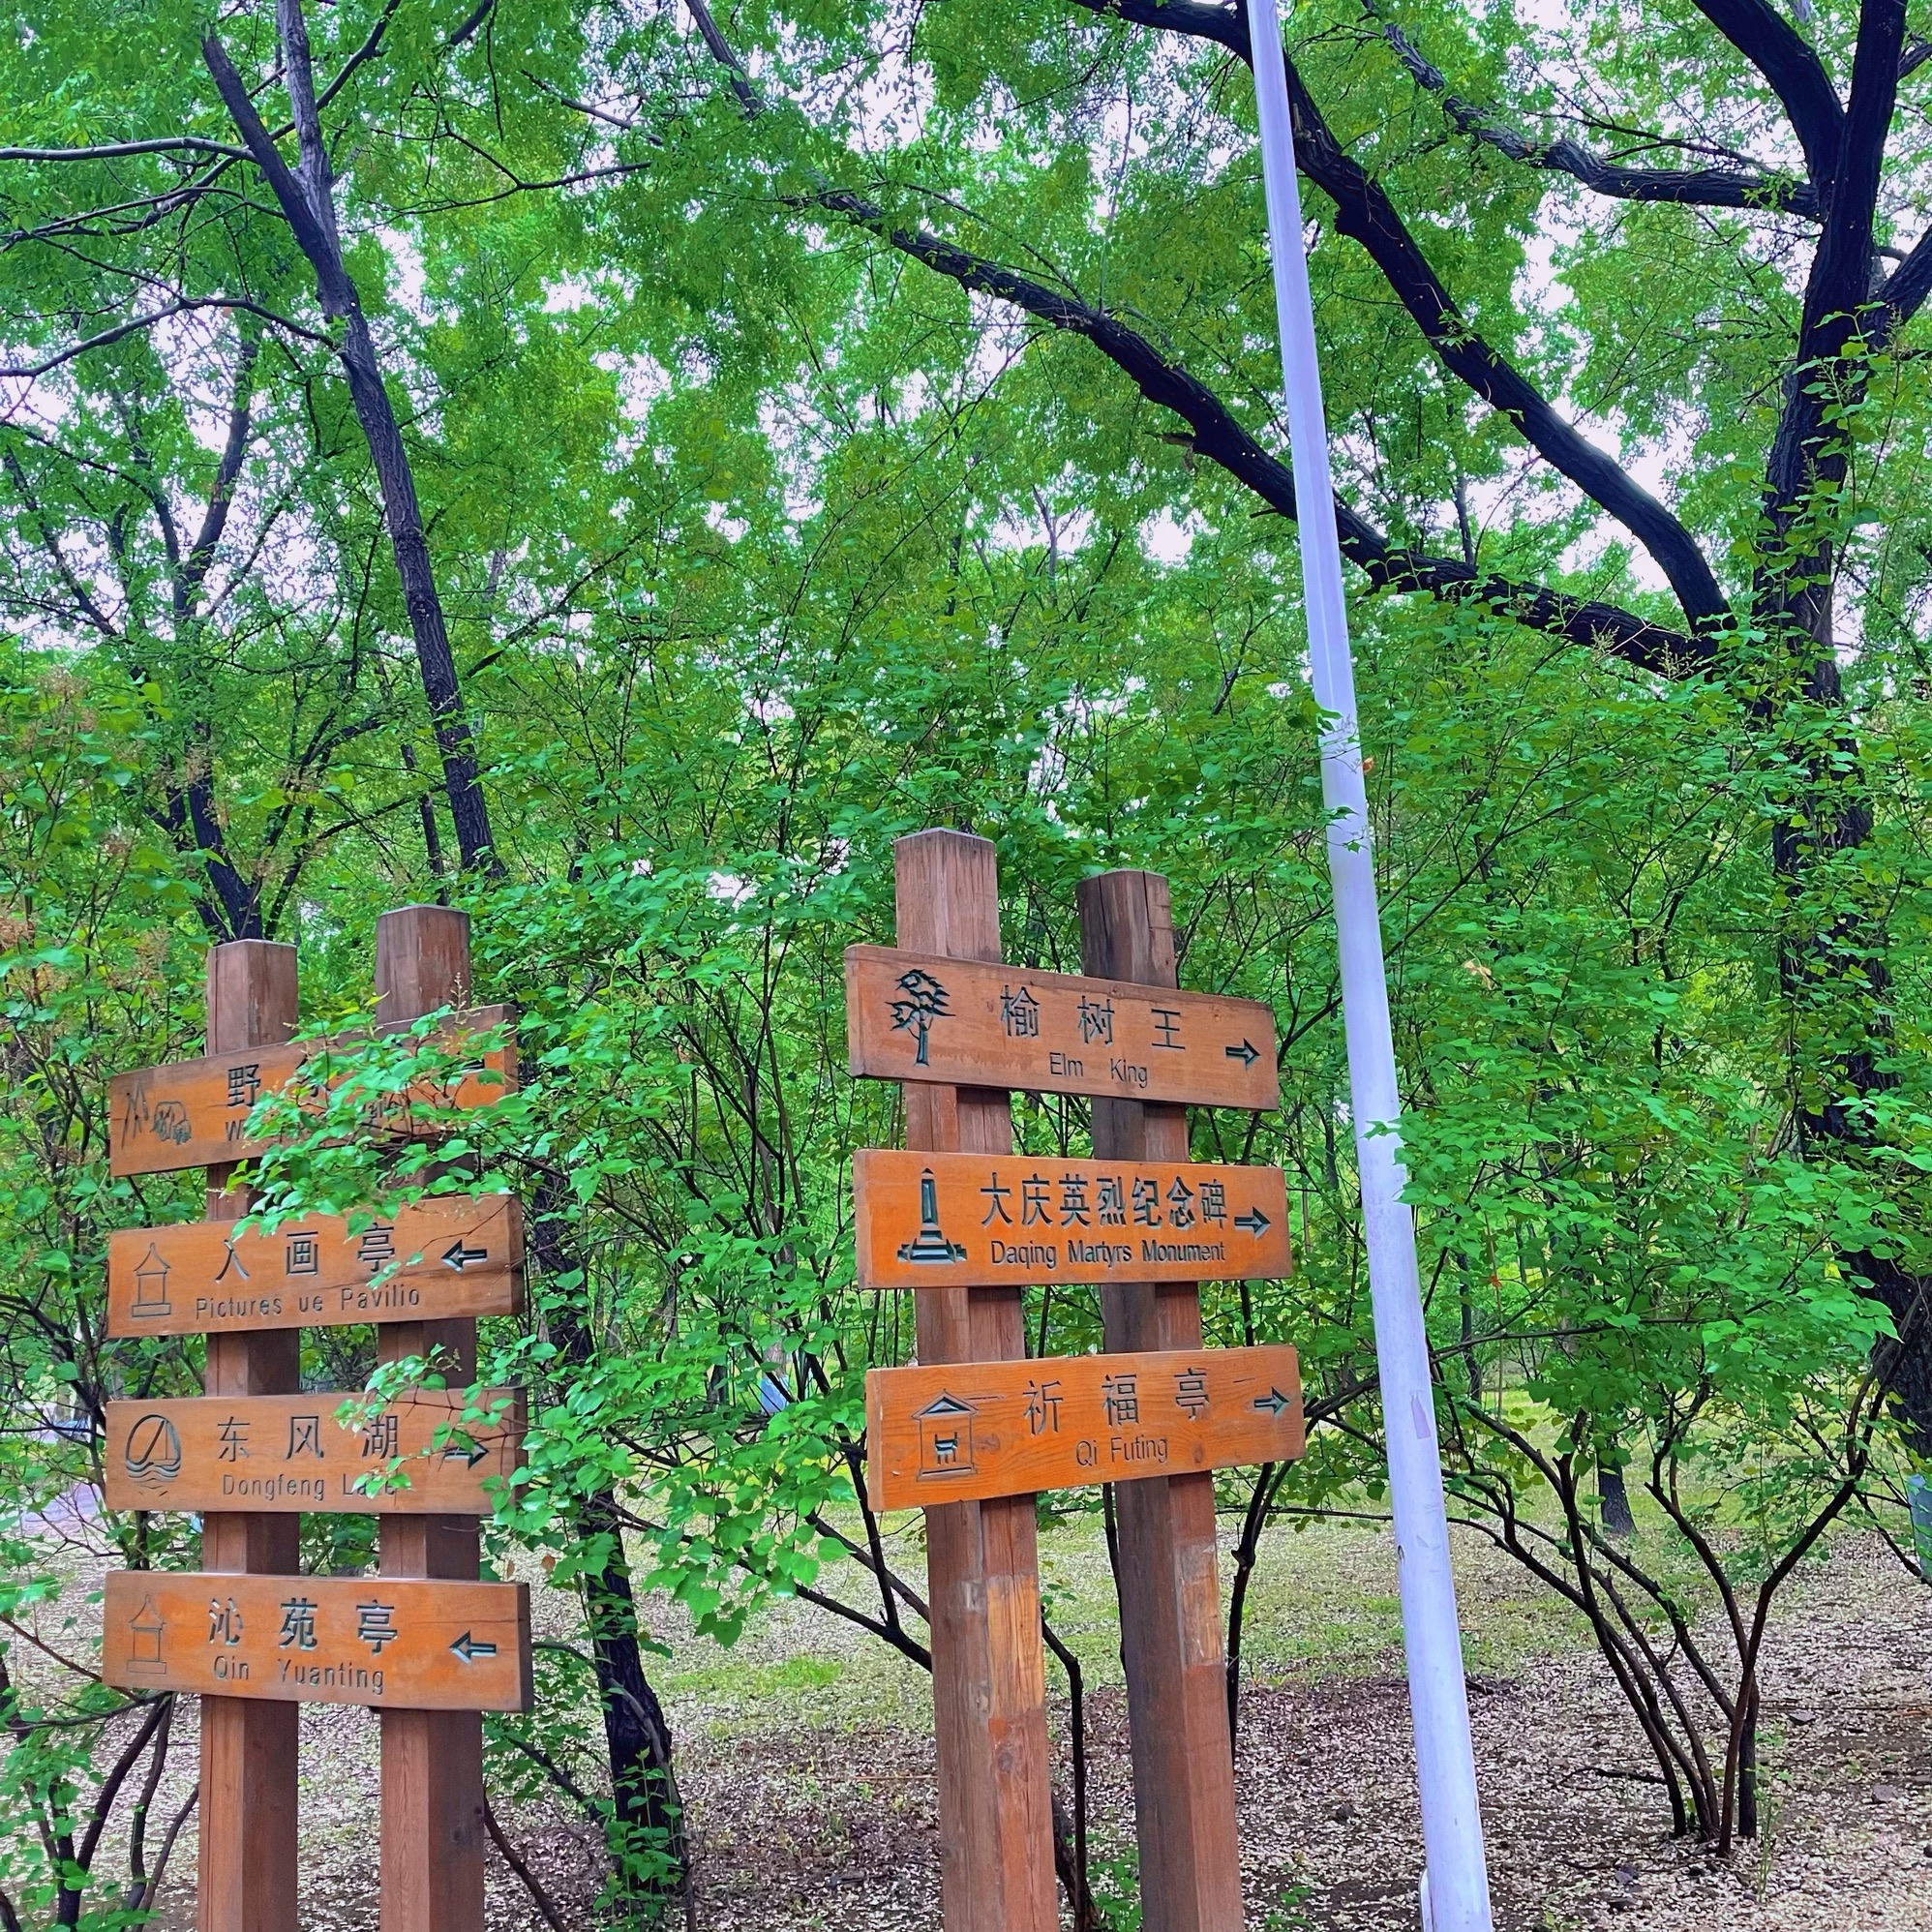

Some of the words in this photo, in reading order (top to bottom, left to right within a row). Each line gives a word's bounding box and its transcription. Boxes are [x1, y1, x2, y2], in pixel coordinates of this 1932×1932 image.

[999, 984, 1187, 1050] 榆树王
[1048, 1051, 1084, 1077] Elm
[1110, 1058, 1148, 1089] King
[980, 1171, 1228, 1230] 大庆英烈纪念碑
[990, 1240, 1057, 1270] Daqing
[1068, 1239, 1132, 1269] Martyrs
[1141, 1239, 1225, 1263] Monument
[196, 1296, 282, 1320] Pictures
[298, 1295, 323, 1313] ue
[341, 1283, 420, 1311] Pavilio
[1022, 1367, 1210, 1436] 祈福亭
[217, 1415, 399, 1463] 东风湖
[1075, 1439, 1098, 1467] Qi
[1110, 1434, 1168, 1464] Futing
[222, 1473, 325, 1502] Dongfeng
[343, 1472, 396, 1495] Lae
[208, 1597, 399, 1655] 沁苑亭
[213, 1655, 250, 1681] Qin
[278, 1658, 384, 1695] Yuanting
